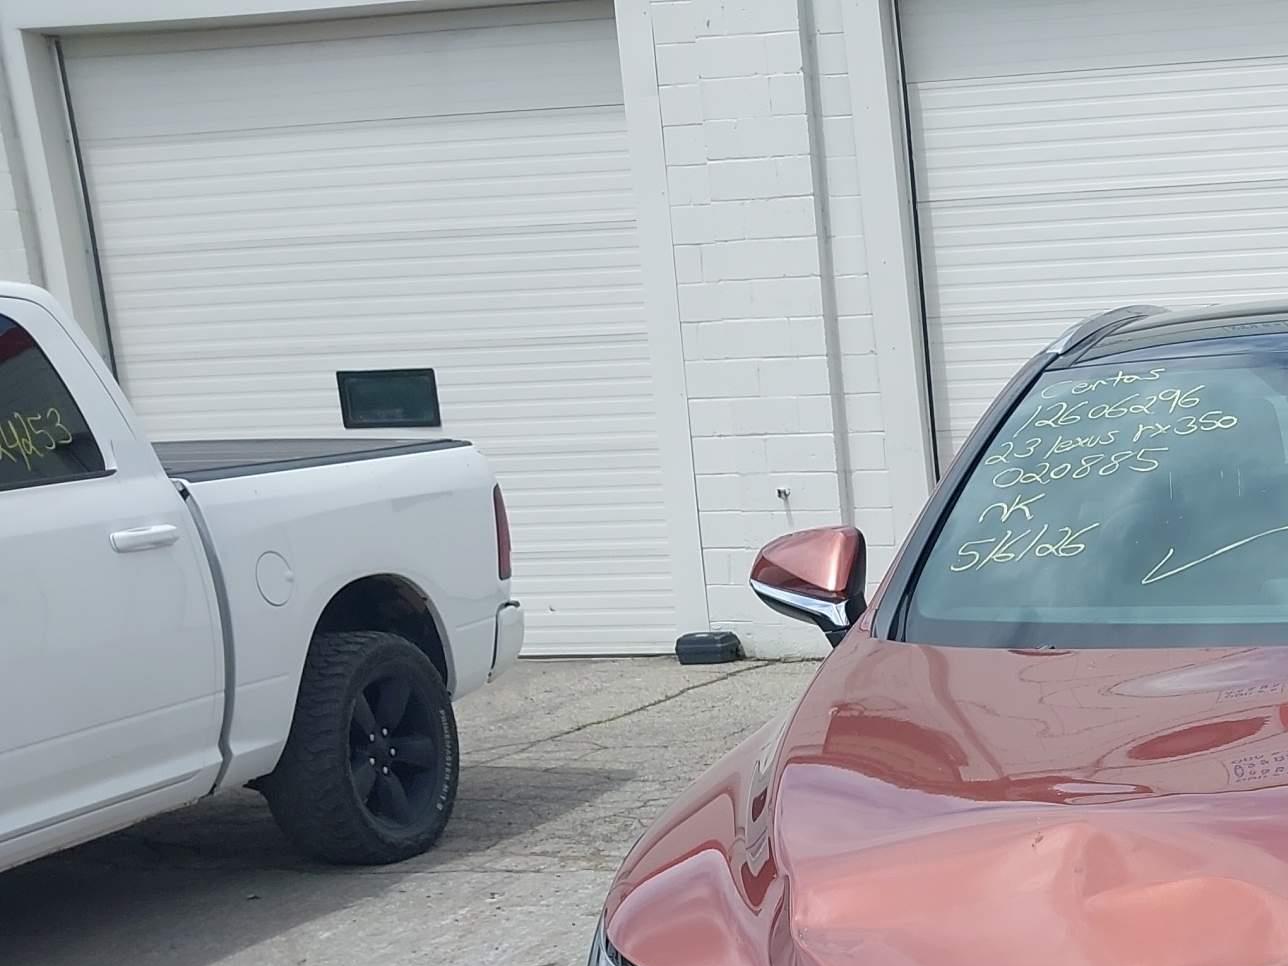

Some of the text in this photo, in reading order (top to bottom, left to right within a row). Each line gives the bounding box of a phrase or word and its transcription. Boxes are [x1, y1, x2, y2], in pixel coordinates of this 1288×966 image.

[1012, 384, 1206, 438] 12606296
[0, 407, 73, 472] 4253
[984, 437, 1042, 465] 23
[992, 447, 1169, 488] 020885
